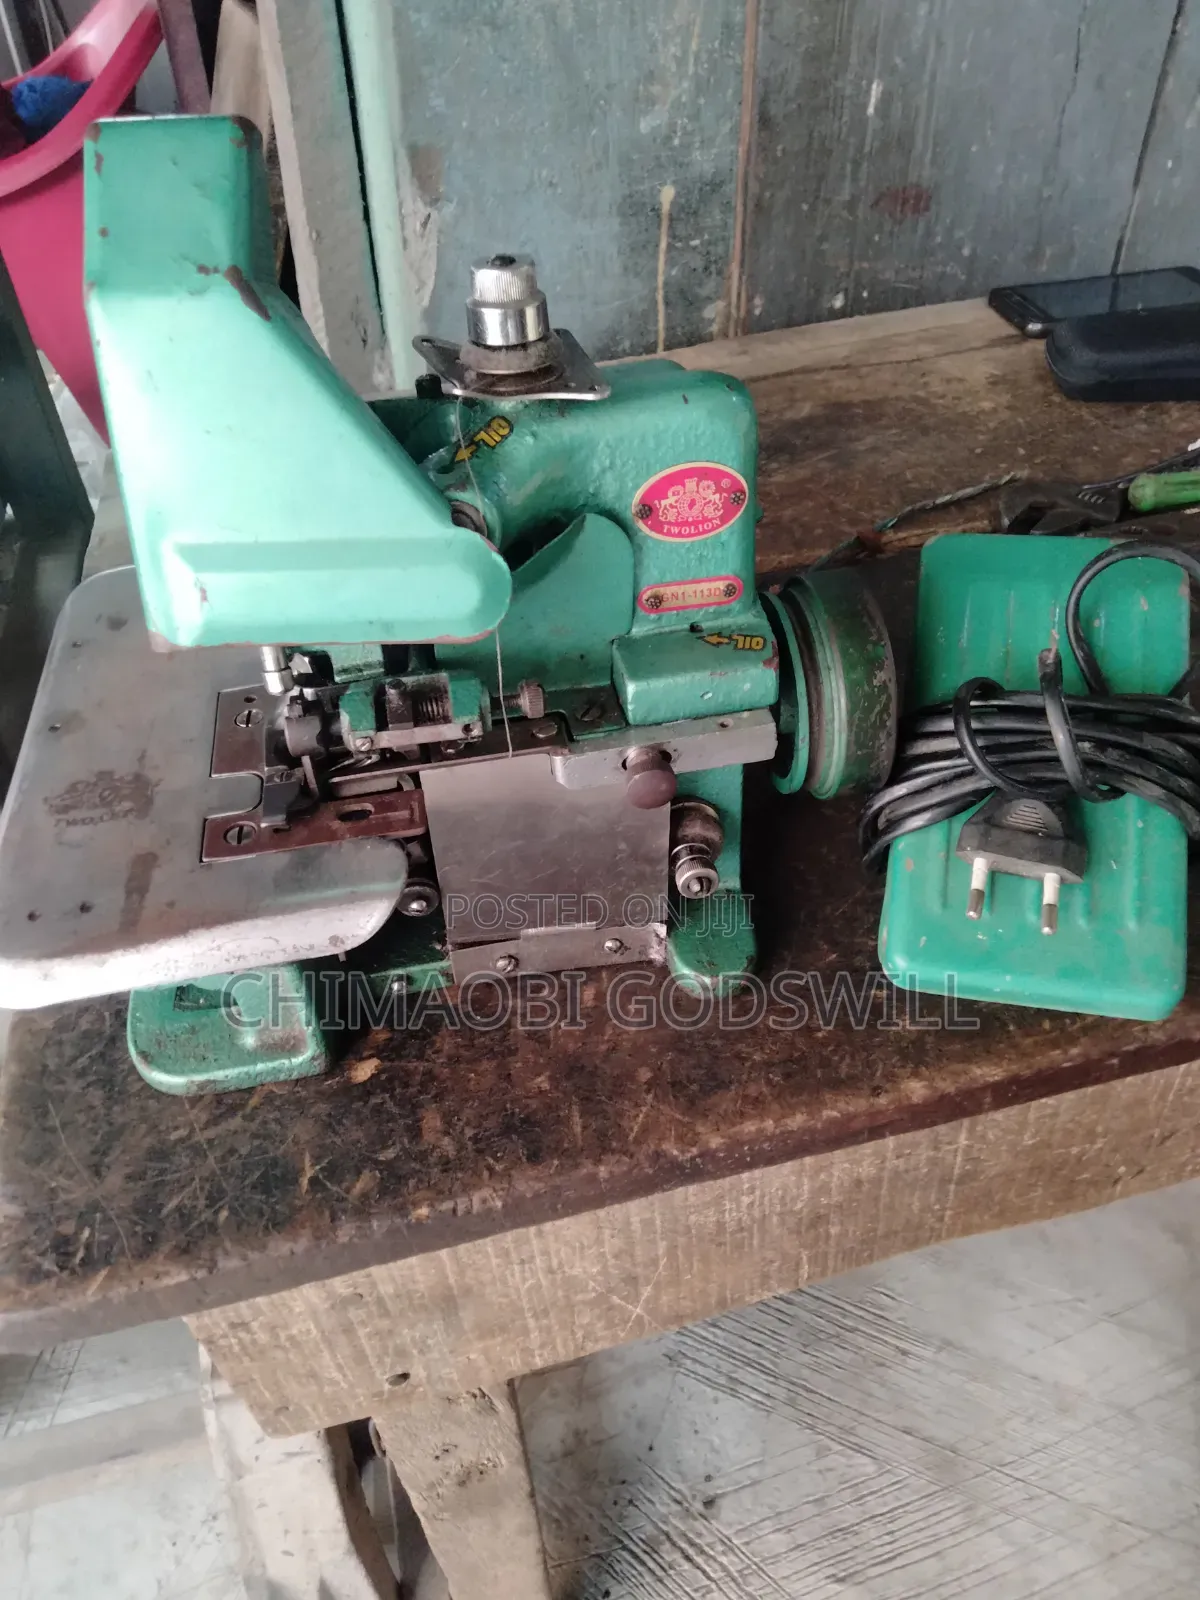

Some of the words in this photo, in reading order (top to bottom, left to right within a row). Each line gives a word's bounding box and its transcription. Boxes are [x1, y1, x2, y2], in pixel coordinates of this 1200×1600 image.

[473, 416, 513, 447] OIL
[663, 518, 721, 535] TWOLION
[731, 634, 764, 650] OIL
